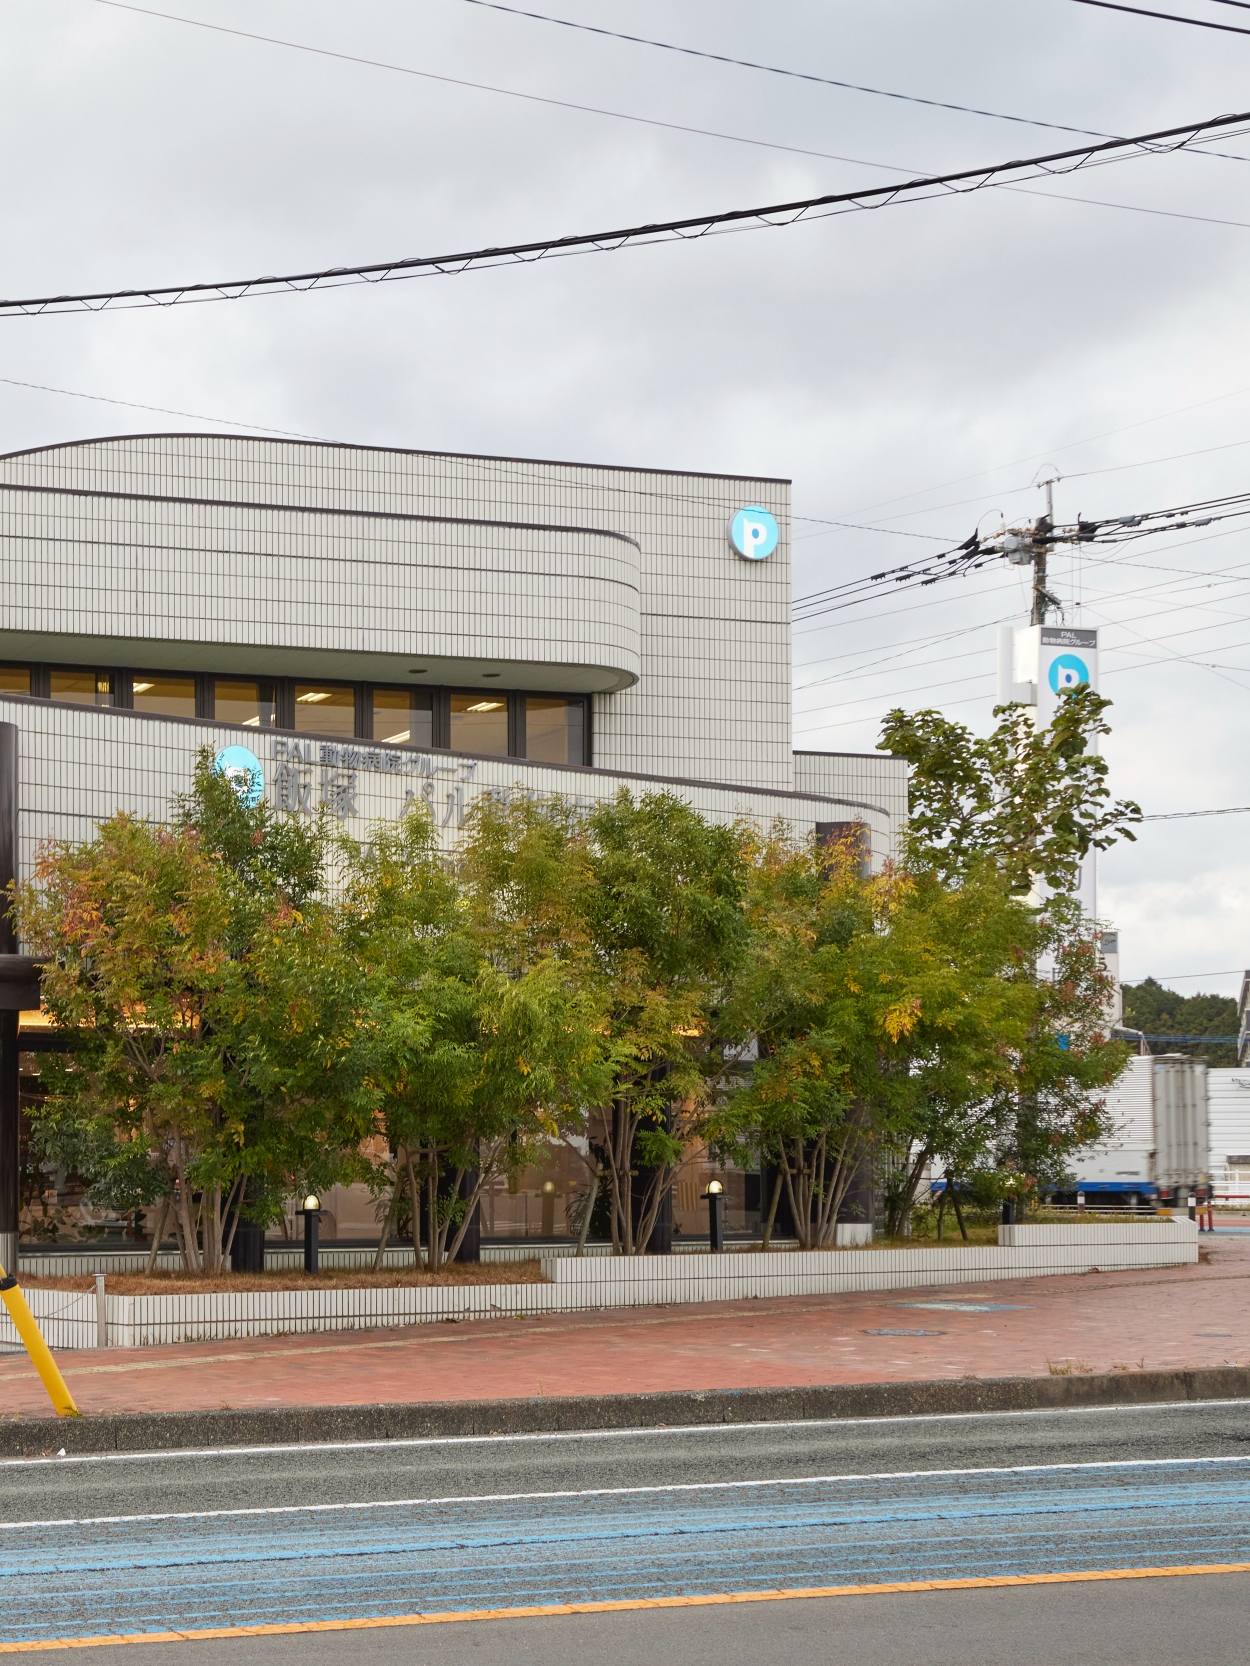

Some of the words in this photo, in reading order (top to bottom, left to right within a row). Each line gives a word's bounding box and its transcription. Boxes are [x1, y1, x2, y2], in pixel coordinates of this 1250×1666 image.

[1042, 636, 1096, 647] 動物病院グループ
[1061, 631, 1077, 639] PAL
[270, 739, 478, 782] PAL動物病院グループ
[272, 762, 359, 821] 飯塚
